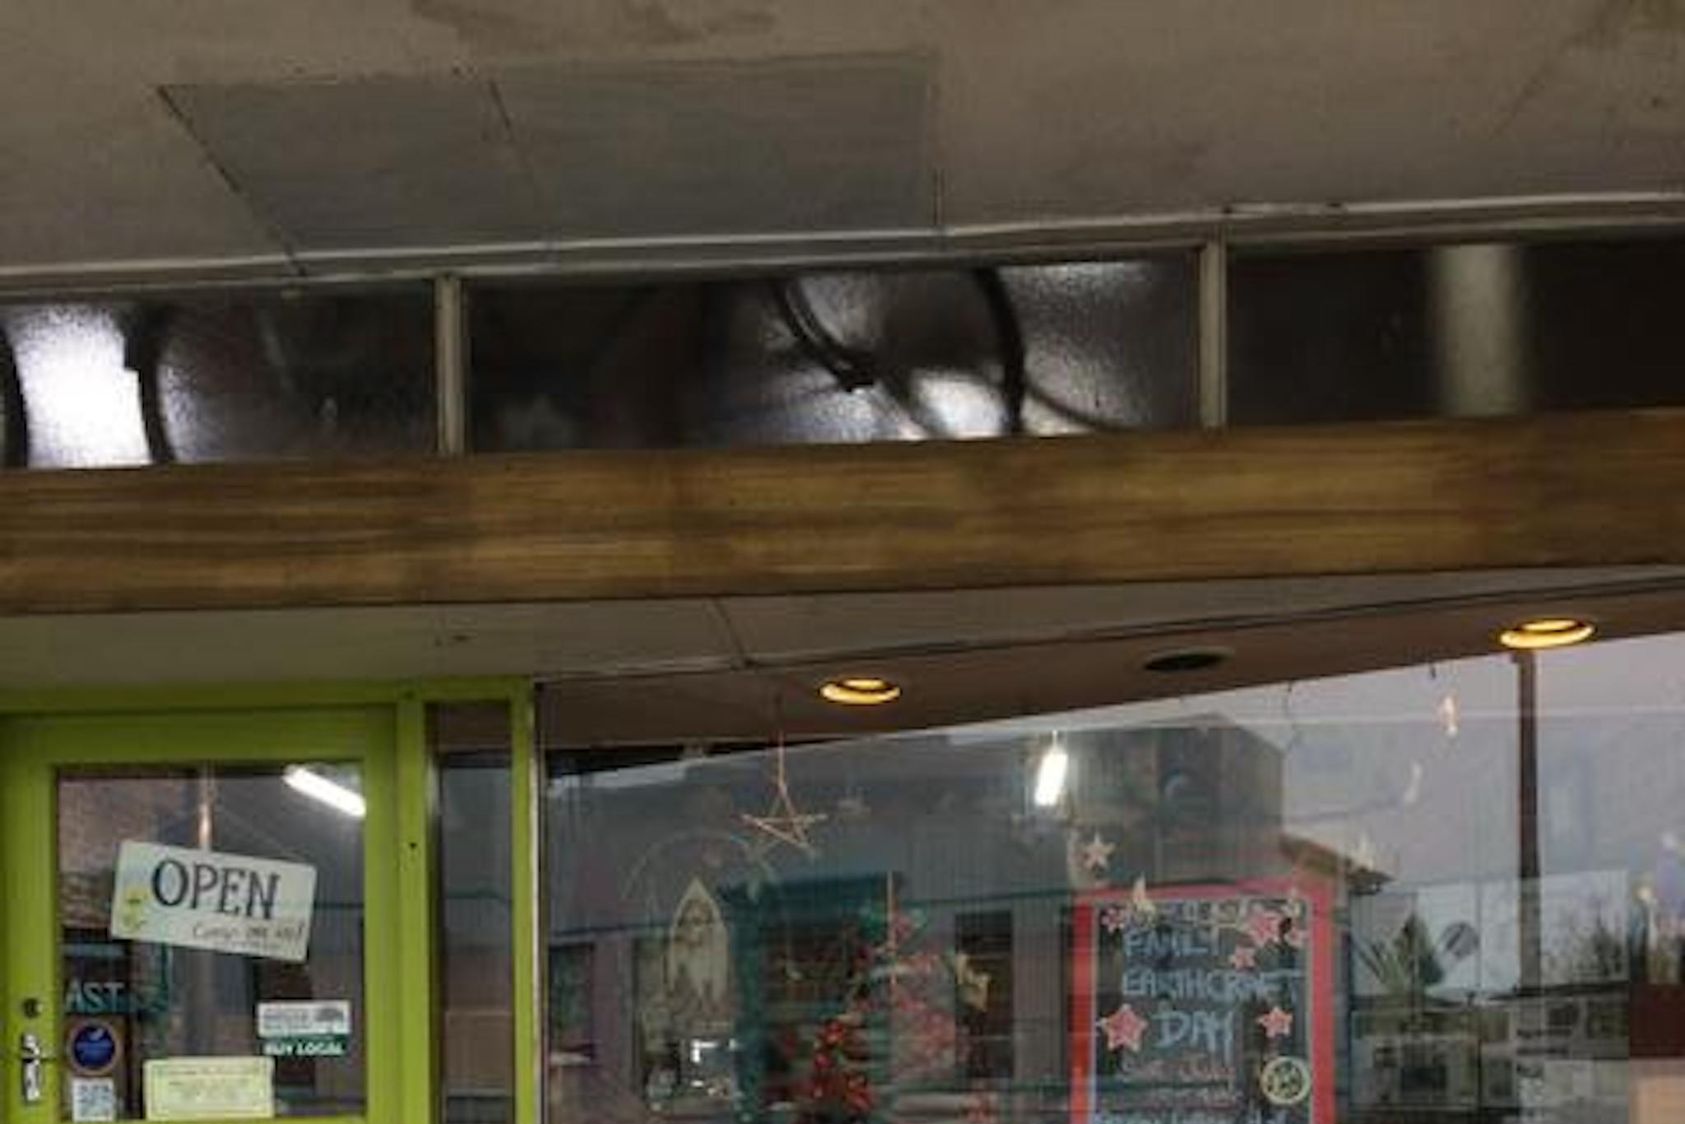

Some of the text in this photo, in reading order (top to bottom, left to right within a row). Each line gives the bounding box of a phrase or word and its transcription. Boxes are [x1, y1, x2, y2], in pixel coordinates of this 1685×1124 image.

[152, 858, 280, 919] OPEN
[296, 1041, 344, 1056] LOCAL
[1151, 1008, 1234, 1064] DAY
